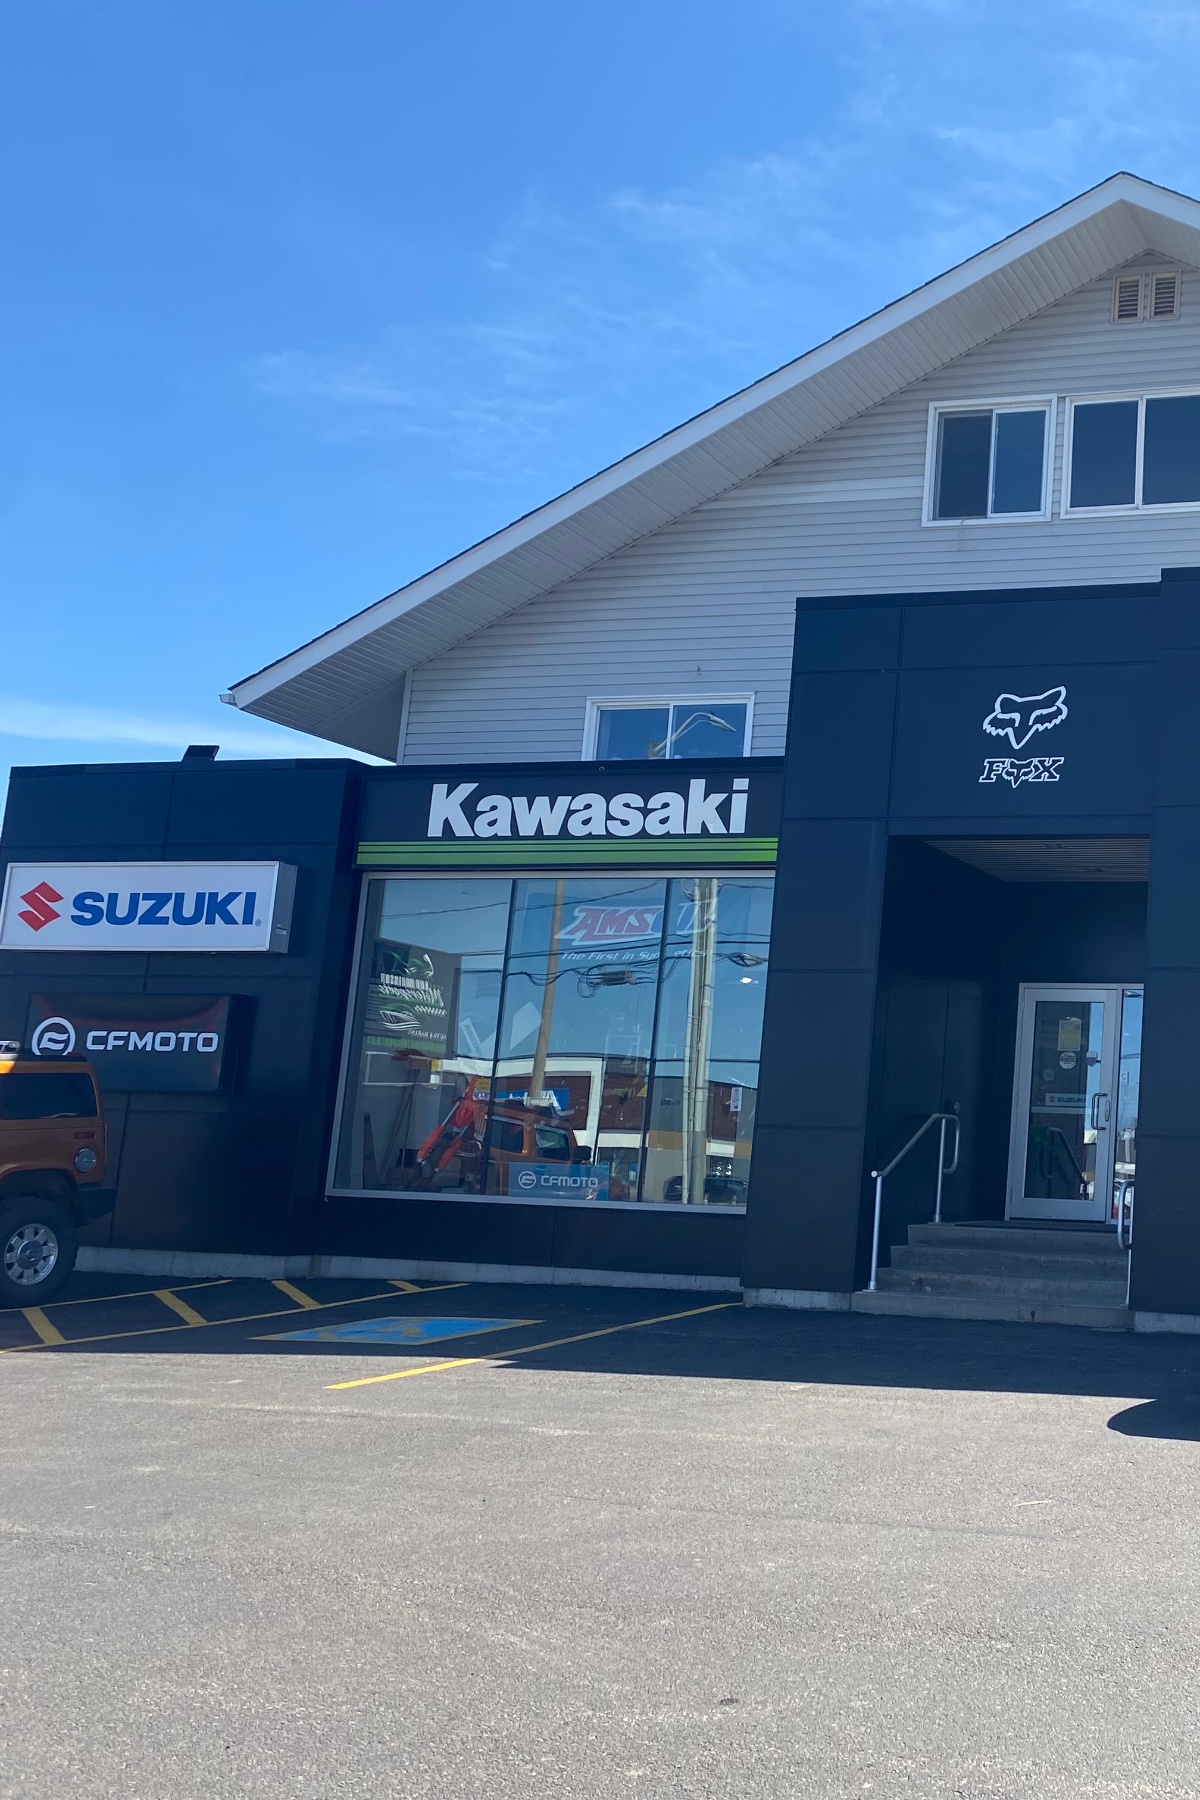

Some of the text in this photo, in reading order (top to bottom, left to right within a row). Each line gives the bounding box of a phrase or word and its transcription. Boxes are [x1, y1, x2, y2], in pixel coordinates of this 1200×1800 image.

[979, 757, 1065, 788] FOX
[427, 778, 750, 837] Kawasaki
[71, 891, 257, 926] SUZUKI
[561, 951, 586, 961] The
[590, 951, 619, 960] First
[622, 950, 635, 960] in
[86, 1030, 219, 1053] CFMOTO
[540, 1175, 599, 1188] CFMOTO
